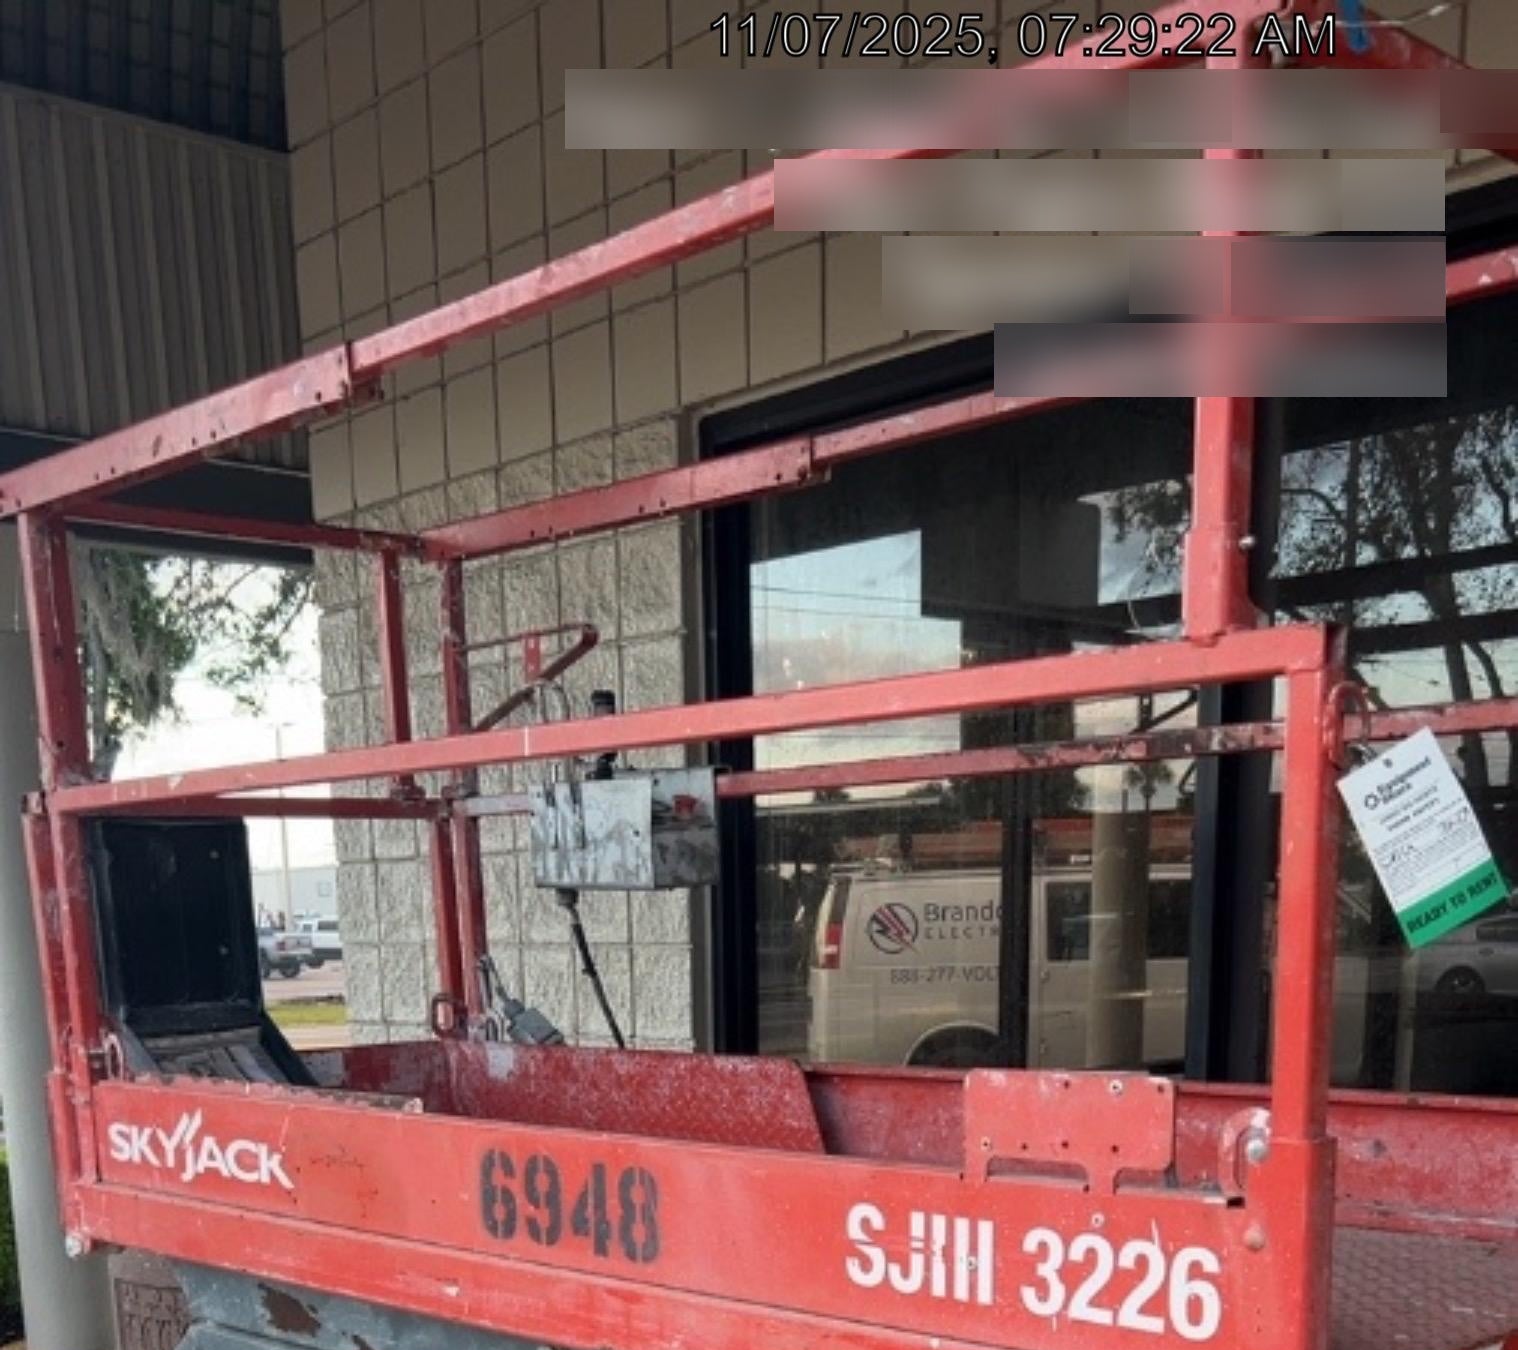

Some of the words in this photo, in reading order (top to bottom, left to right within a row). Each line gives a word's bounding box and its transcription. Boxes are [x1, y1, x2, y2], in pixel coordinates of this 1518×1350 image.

[1406, 904, 1450, 933] READY
[1450, 892, 1468, 909] TO
[108, 1109, 294, 1189] SKYJACK
[479, 1148, 661, 1264] 6948
[845, 1203, 994, 1306] SJIII
[1019, 1226, 1222, 1341] 3226
